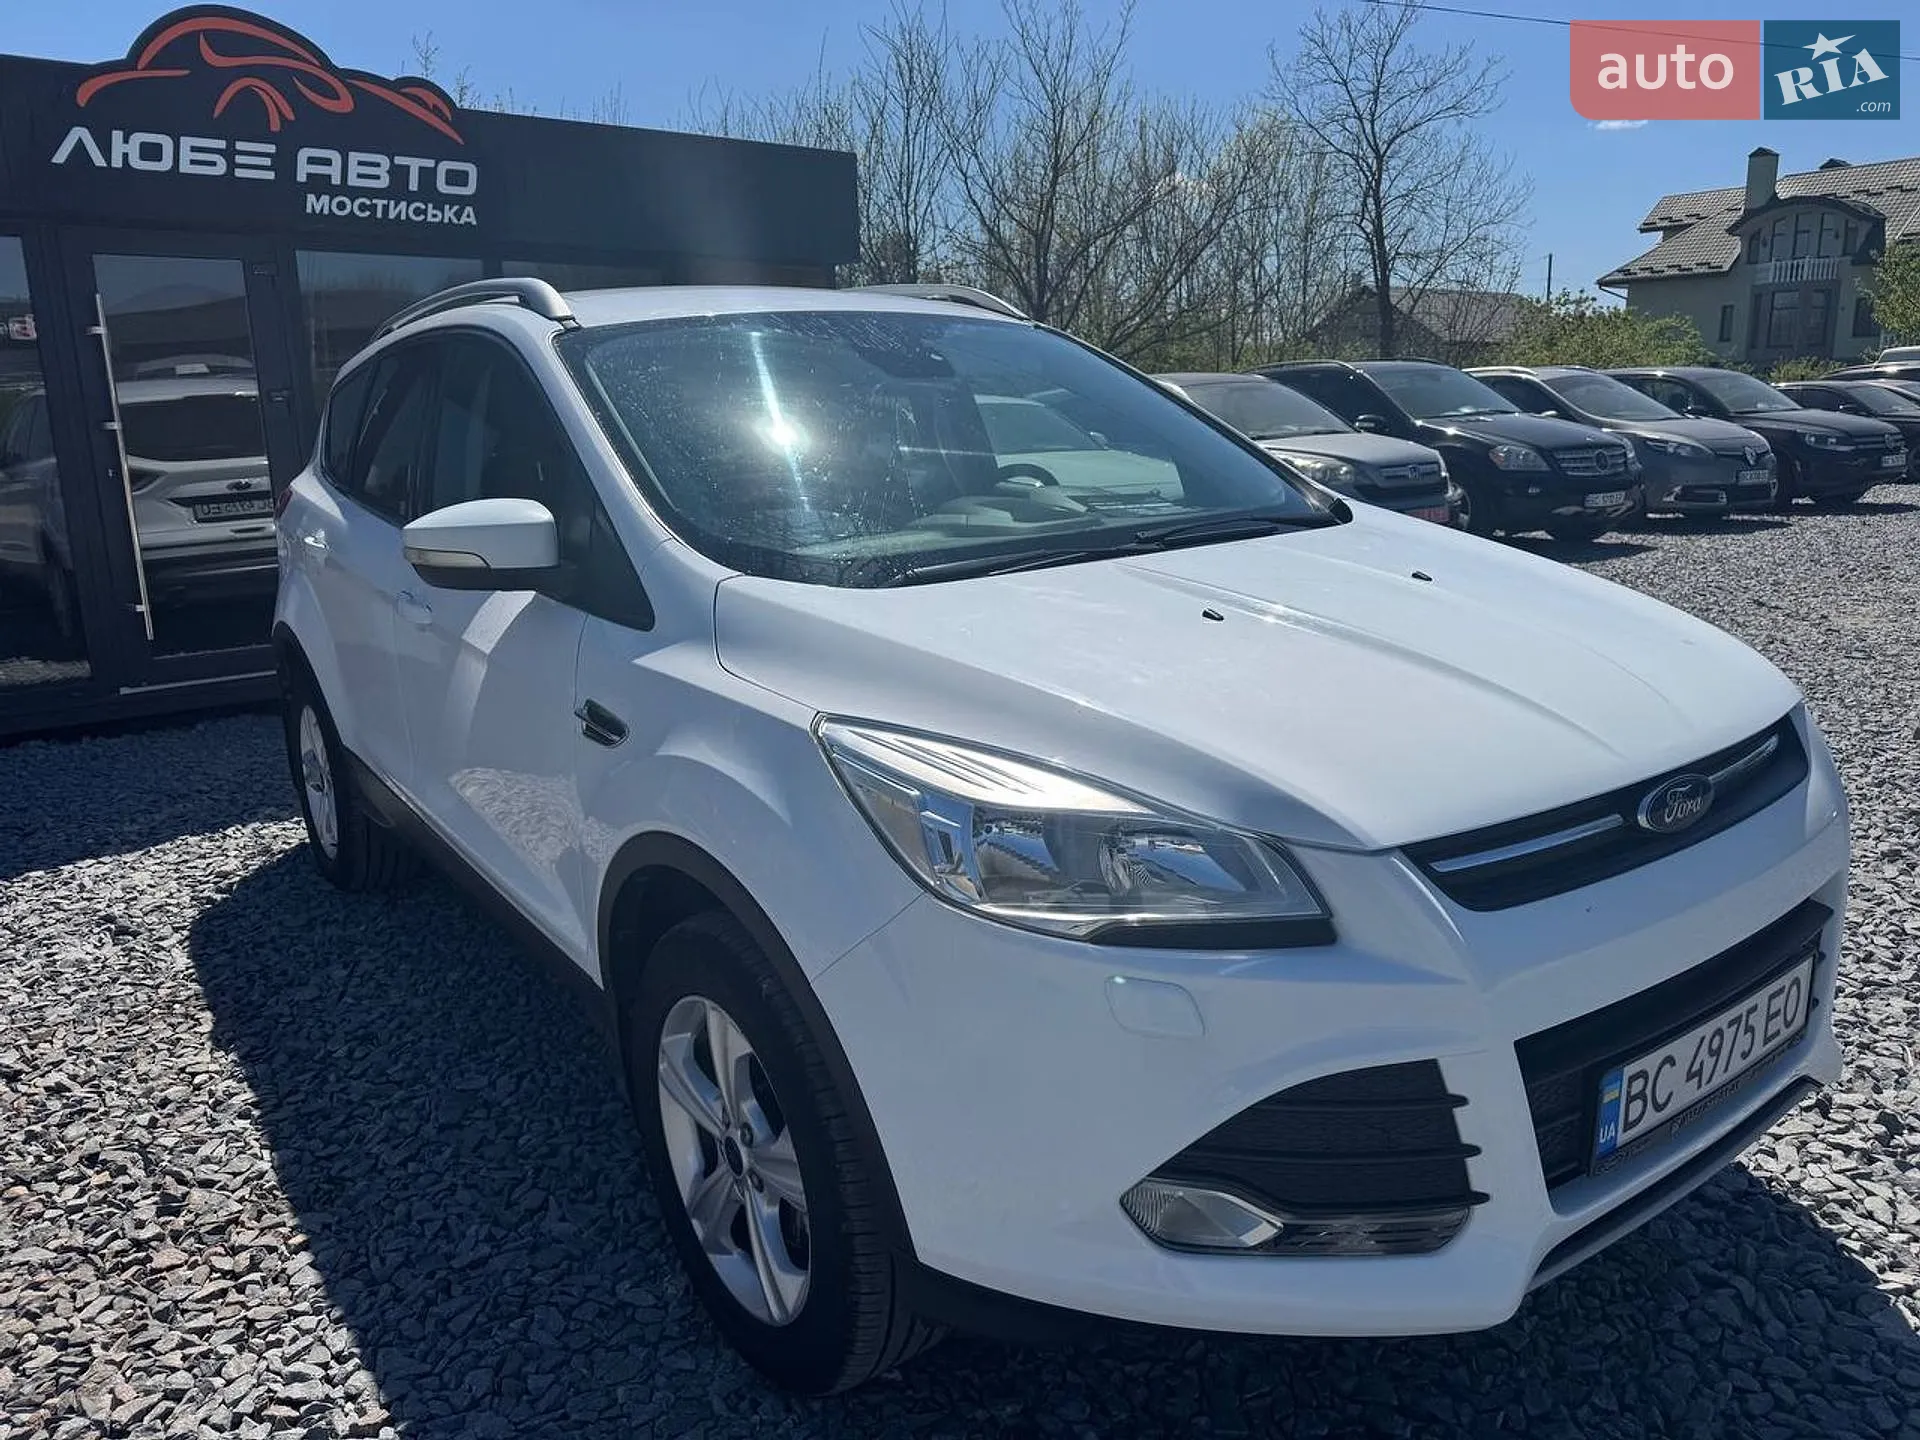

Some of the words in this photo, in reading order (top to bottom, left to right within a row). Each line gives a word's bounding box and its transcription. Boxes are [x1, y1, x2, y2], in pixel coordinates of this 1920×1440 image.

[51, 126, 276, 180] ЛЮБЕ
[296, 147, 477, 195] АВТО
[305, 193, 477, 226] МОСТИСЬКА
[1664, 784, 1704, 823] Ford
[1624, 1054, 1676, 1132] BC
[1685, 1005, 1758, 1090] 4975
[1763, 976, 1802, 1047] EO
[1599, 1124, 1616, 1144] UA
